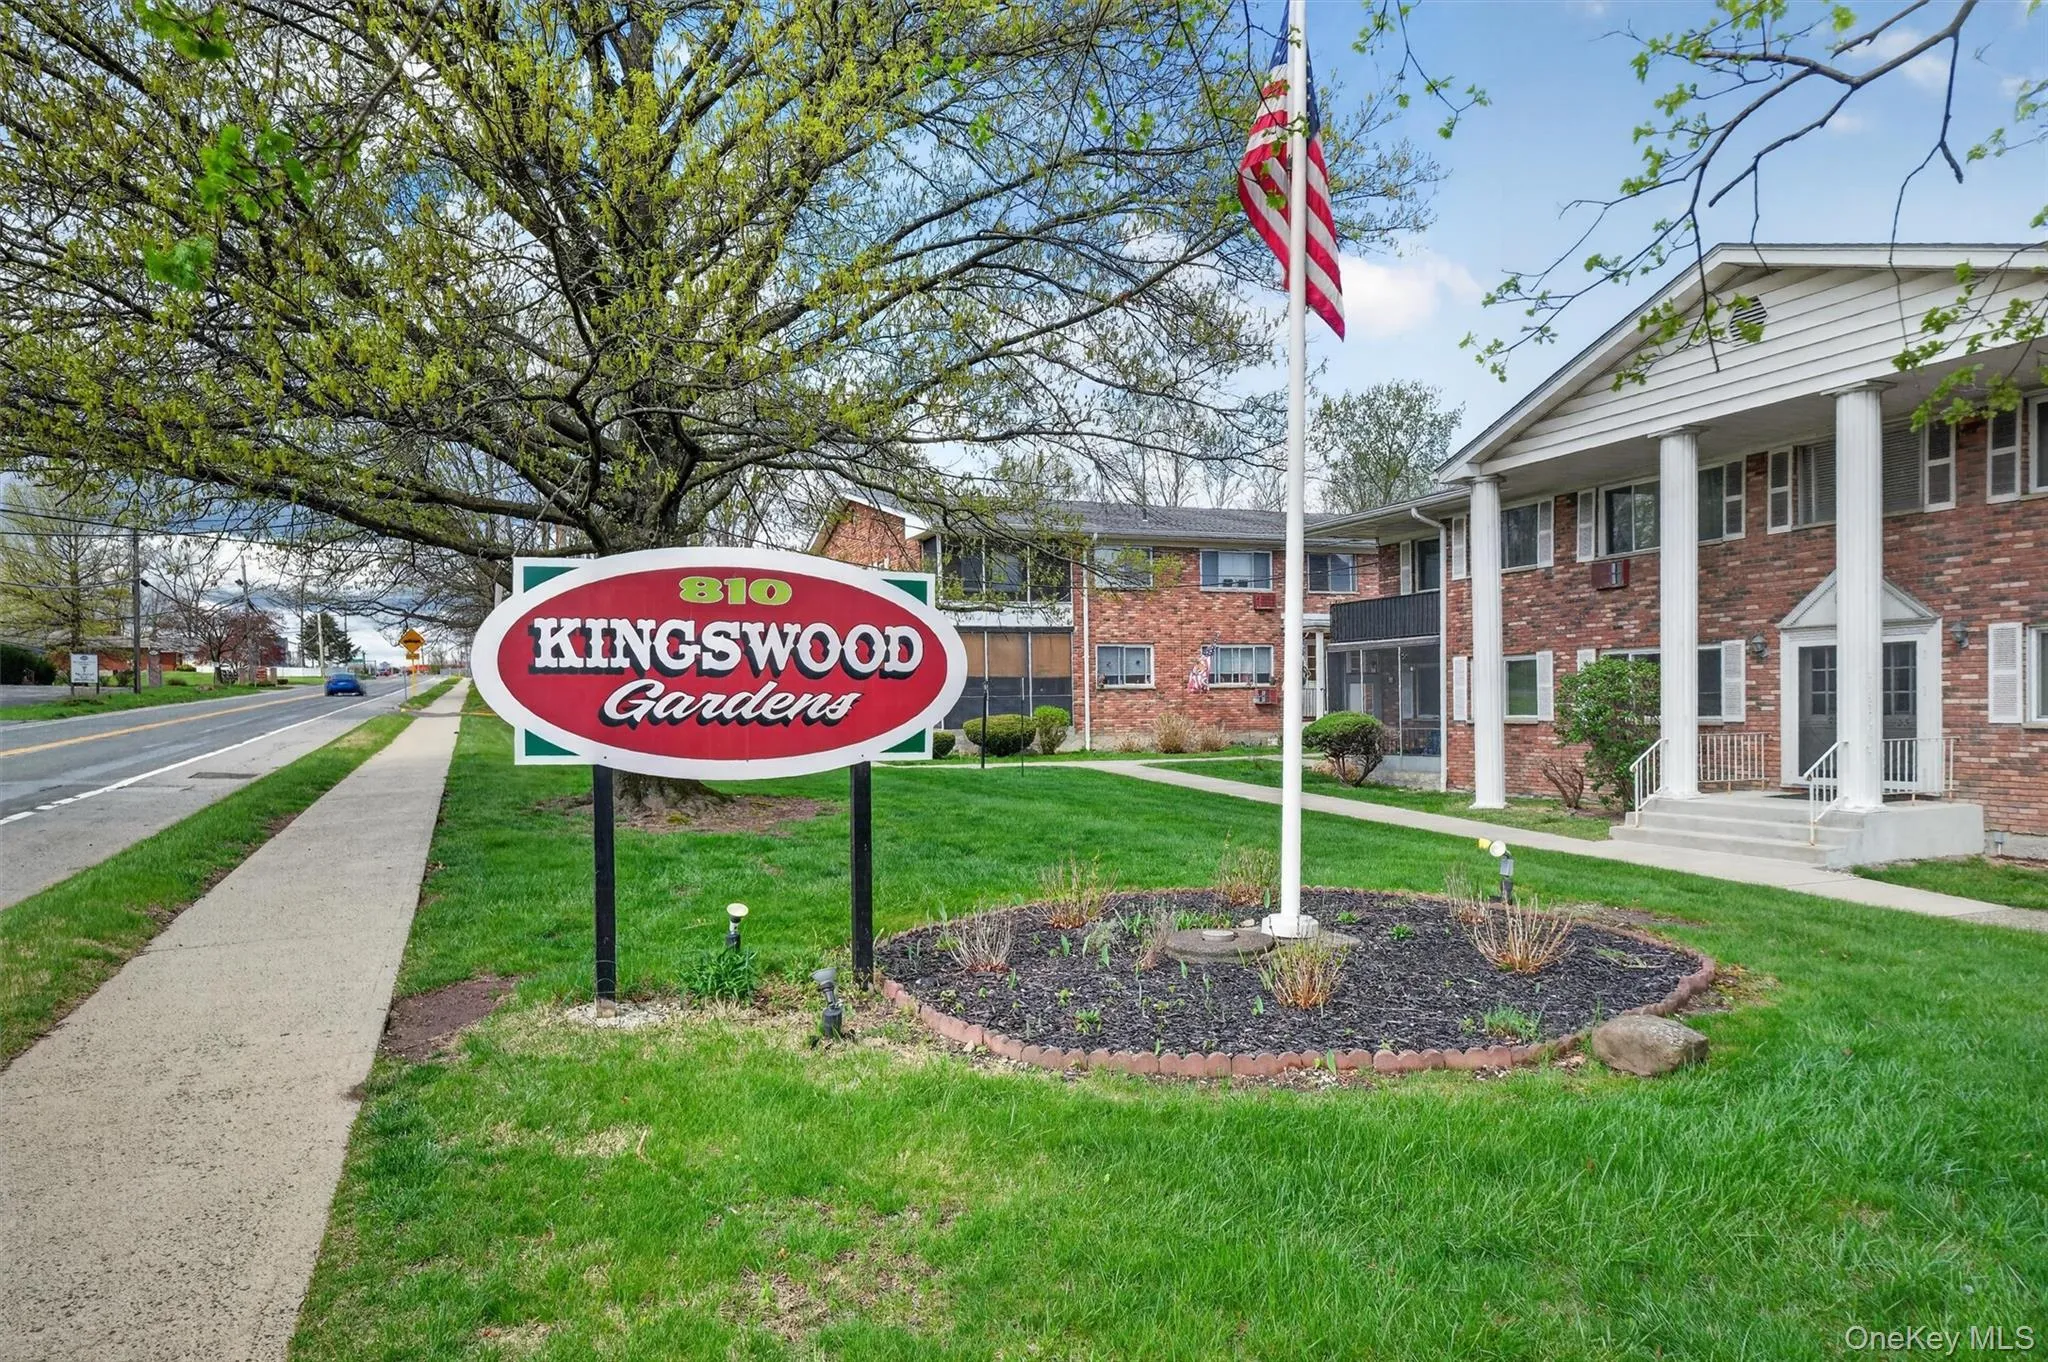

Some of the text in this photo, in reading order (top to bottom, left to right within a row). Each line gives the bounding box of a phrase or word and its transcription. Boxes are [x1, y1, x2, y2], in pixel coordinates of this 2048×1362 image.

[679, 577, 792, 606] 810
[529, 617, 923, 677] KINGSWOOD
[600, 678, 861, 728] Gardens
